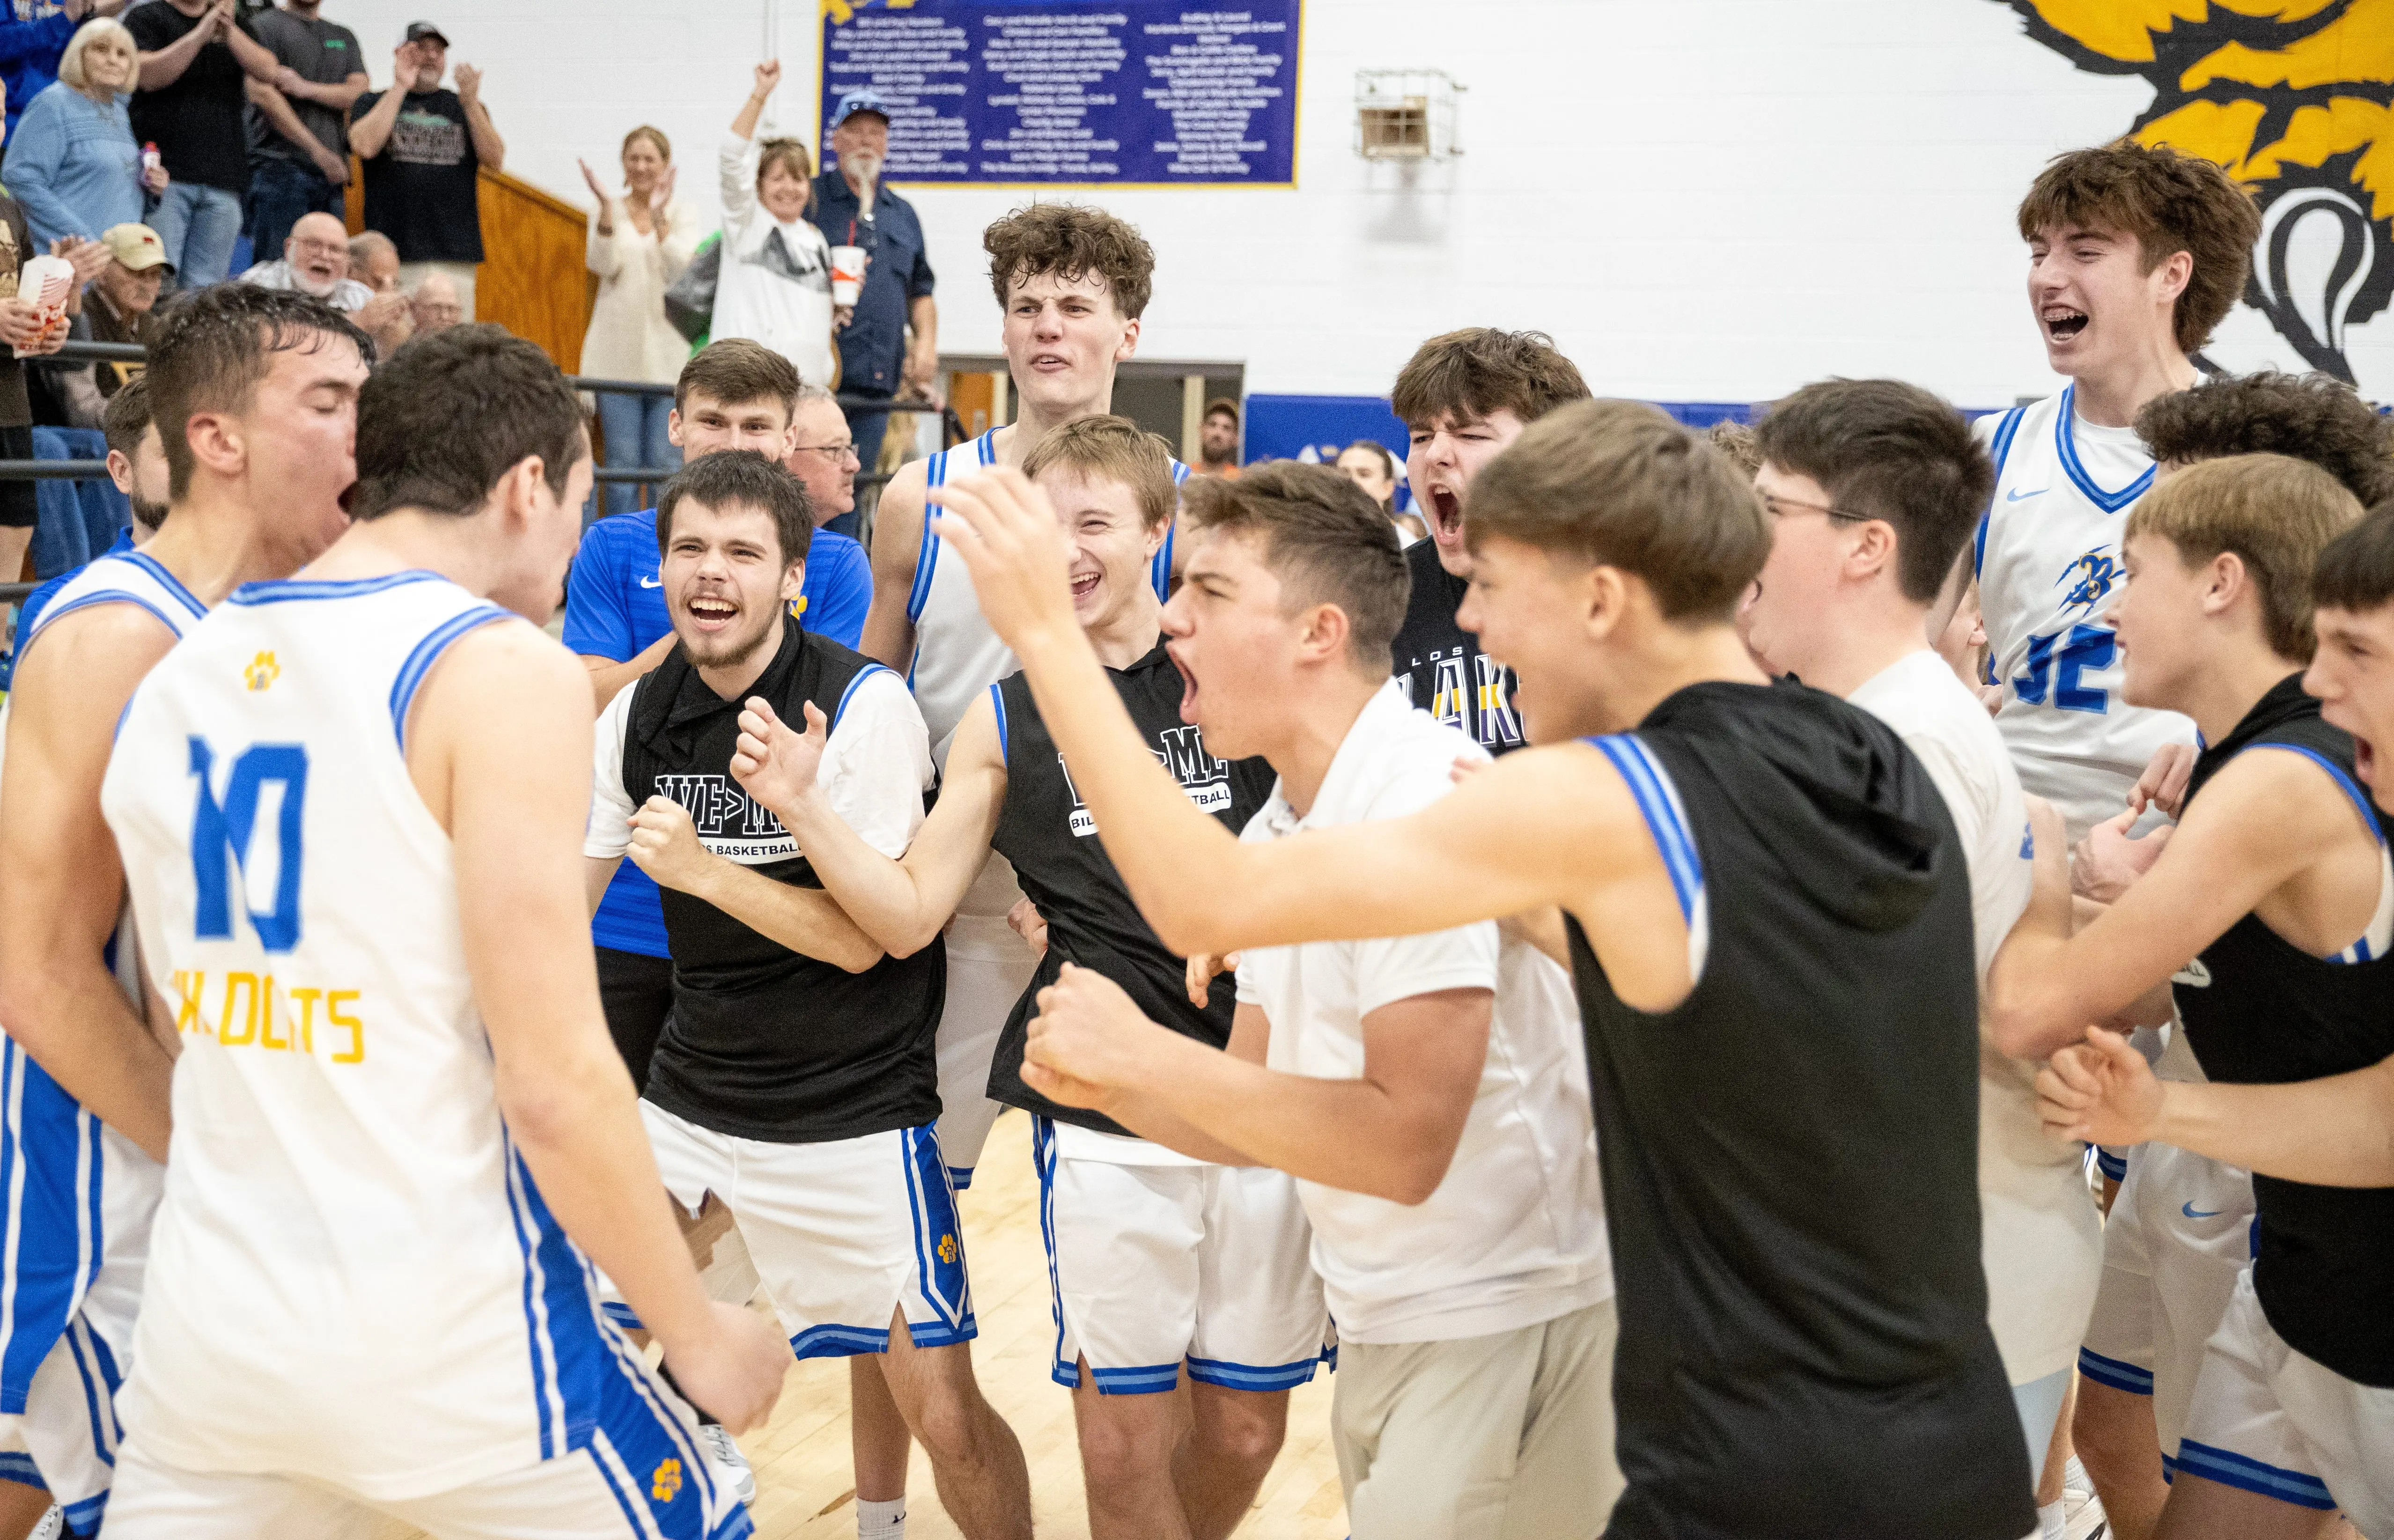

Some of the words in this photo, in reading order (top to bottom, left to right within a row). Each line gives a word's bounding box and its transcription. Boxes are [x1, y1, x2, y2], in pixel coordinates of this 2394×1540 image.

[1412, 646, 1462, 666] LOS
[1397, 654, 1531, 746] AK
[655, 774, 789, 835] WE>M
[1071, 817, 1094, 829] BIL
[1188, 790, 1230, 804] TBALL
[186, 733, 310, 956] 10
